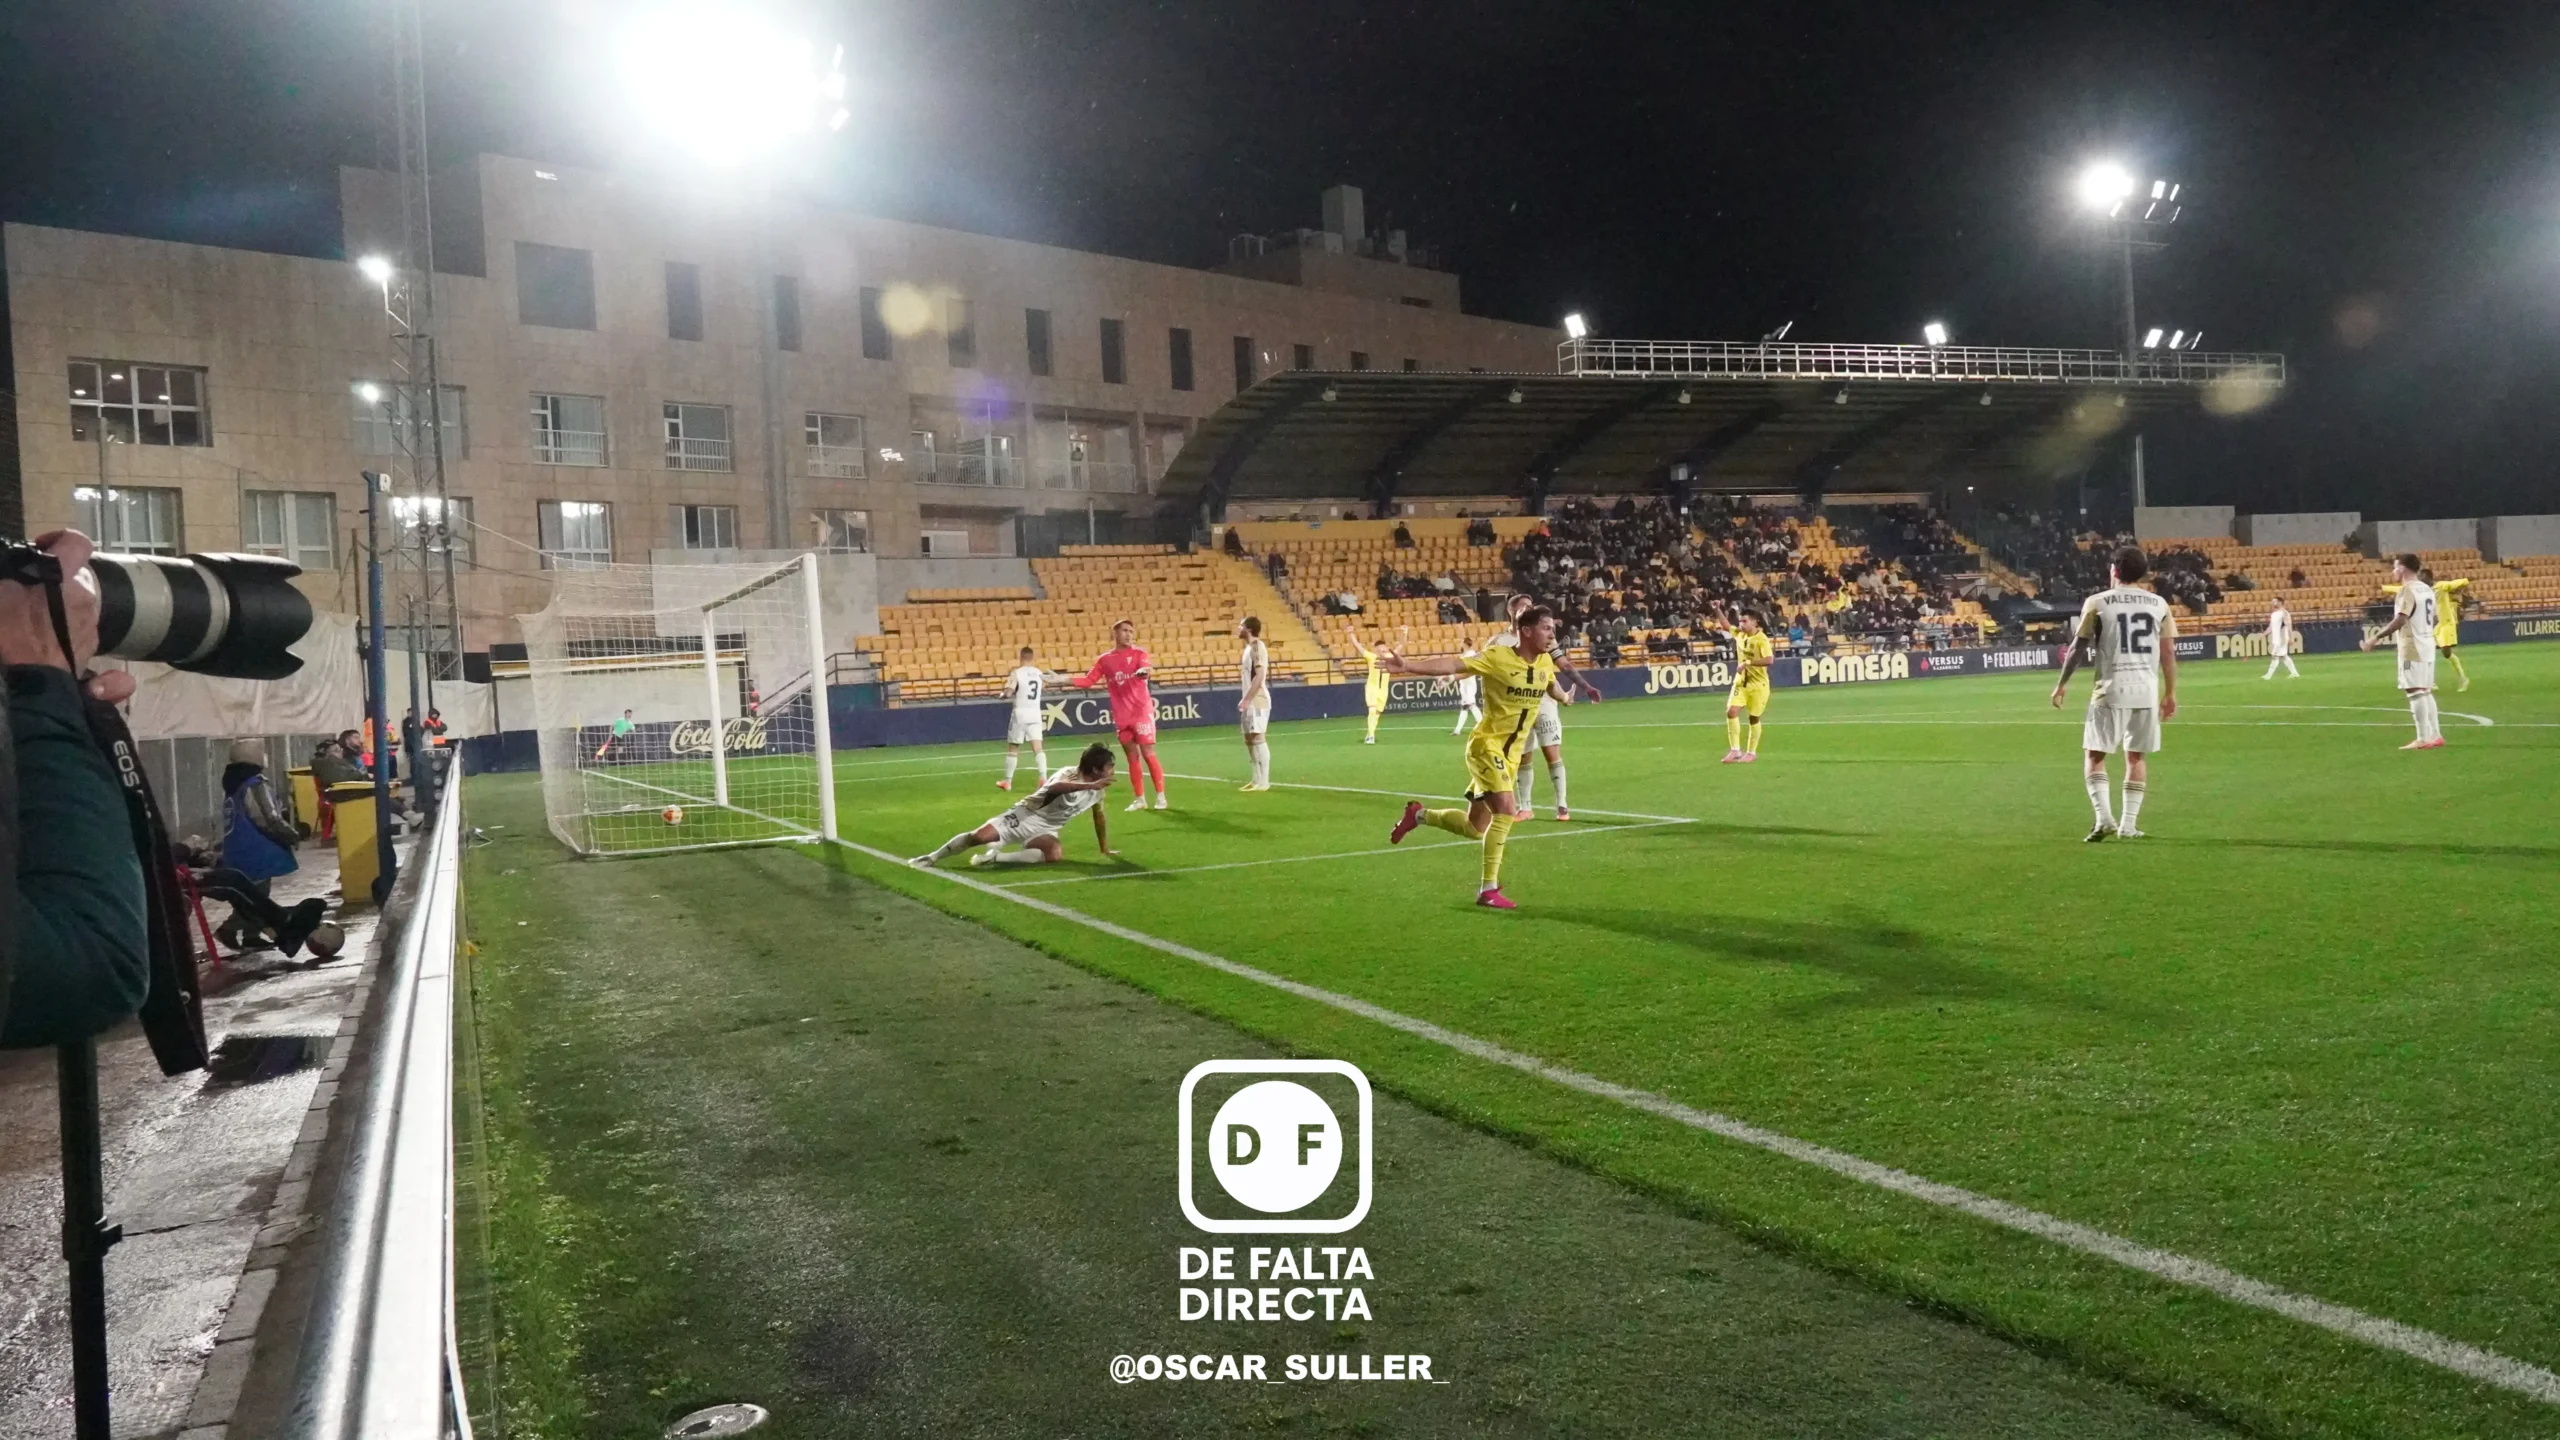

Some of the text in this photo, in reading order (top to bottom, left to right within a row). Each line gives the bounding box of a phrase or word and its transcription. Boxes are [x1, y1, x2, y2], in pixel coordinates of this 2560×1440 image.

[2103, 594, 2159, 607] VALENTINO
[2117, 611, 2153, 654] 12
[2216, 631, 2304, 658] PAMA
[1801, 652, 1909, 684] PAMESA
[1928, 655, 1965, 666] VERSUS
[1994, 648, 2049, 668] FEDERACIÓN
[1027, 680, 1038, 700] 3
[1390, 679, 1461, 700] CERAM
[1075, 694, 1202, 726] CaBank
[1411, 700, 1430, 709] CLUB
[669, 716, 769, 755] CocaCola
[113, 740, 141, 788] EOS
[1004, 813, 1020, 829] 23
